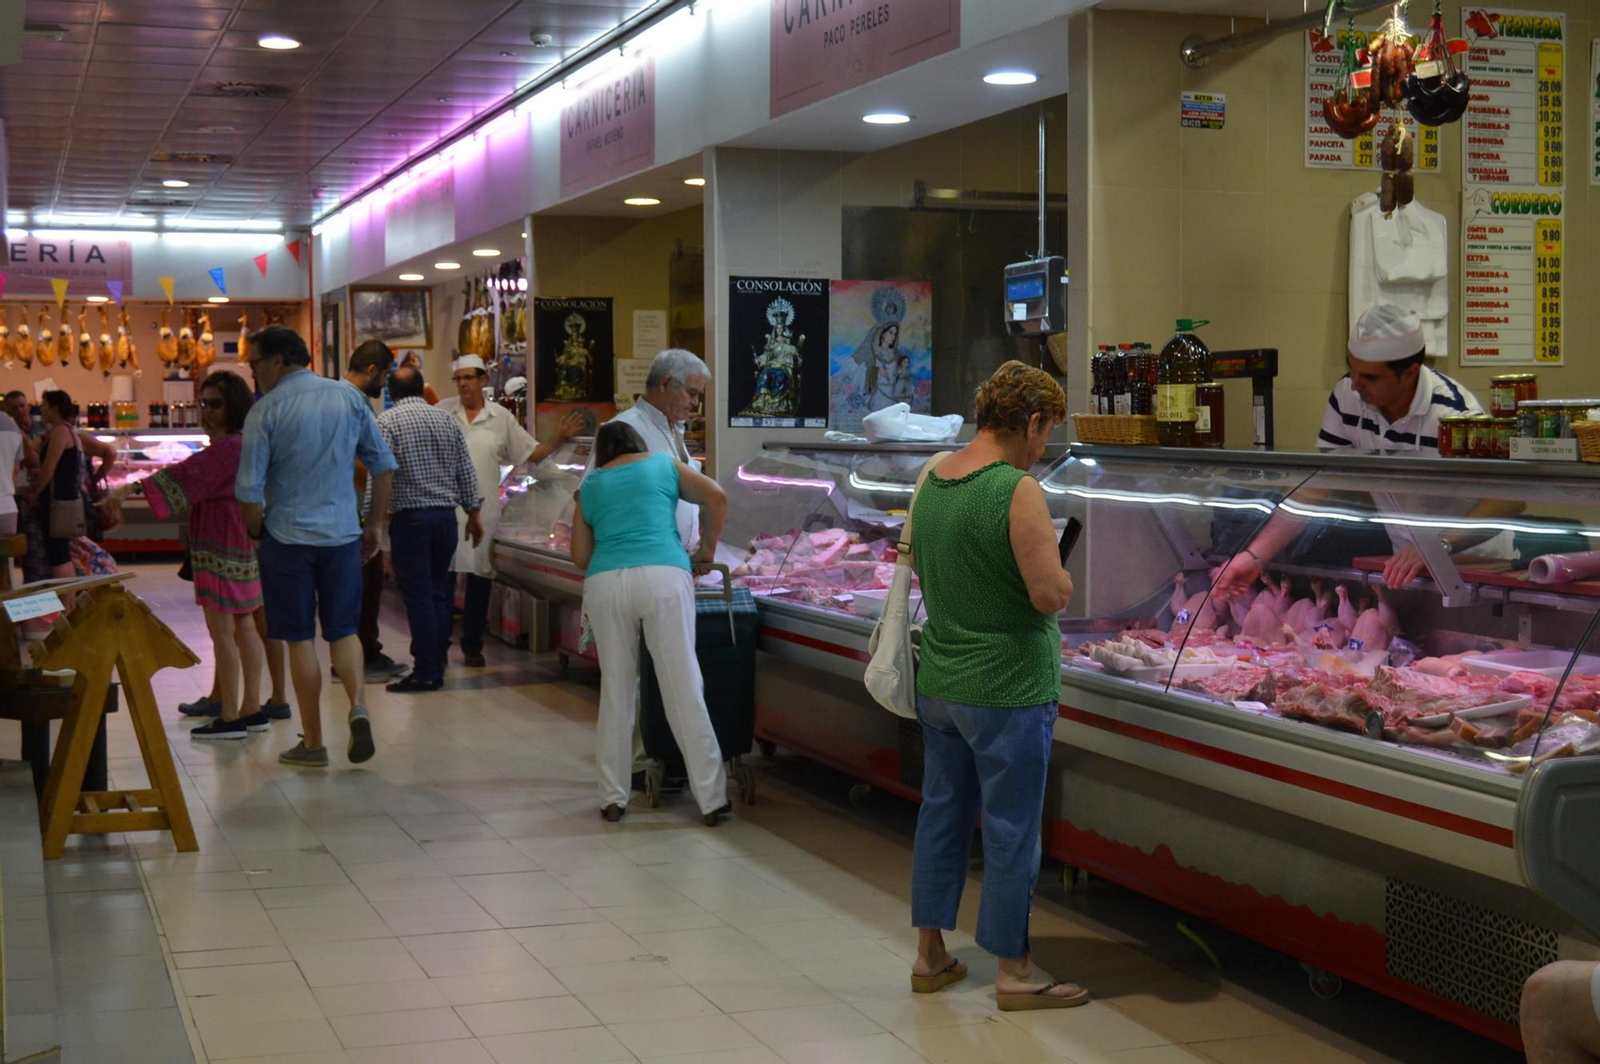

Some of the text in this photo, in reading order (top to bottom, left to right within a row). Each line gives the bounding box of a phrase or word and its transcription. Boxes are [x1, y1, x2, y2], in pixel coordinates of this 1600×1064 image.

[823, 24, 846, 49] PACO
[850, 4, 890, 37] PERELES
[1498, 13, 1563, 40] TERNERA
[1310, 83, 1334, 91] EXTRA
[1468, 106, 1511, 116] PRIMERA-A
[1309, 140, 1345, 149] PANCETA
[1468, 136, 1505, 146] SEGUNDA
[1309, 153, 1342, 162] PAPADA
[1468, 152, 1501, 161] TERCERA
[1468, 167, 1508, 175] CRIADILLAS
[1490, 191, 1563, 216] CORDERO
[1466, 254, 1490, 262] EXTRA
[1466, 270, 1509, 279] PRIMERA-A
[736, 279, 823, 292] CONSOLACIÓN
[1466, 286, 1509, 294] PRIMERA-B
[541, 299, 608, 308] CONSOLACIÓN
[1466, 301, 1510, 309] SEGUNDA-A
[1466, 331, 1499, 339] TERCERA
